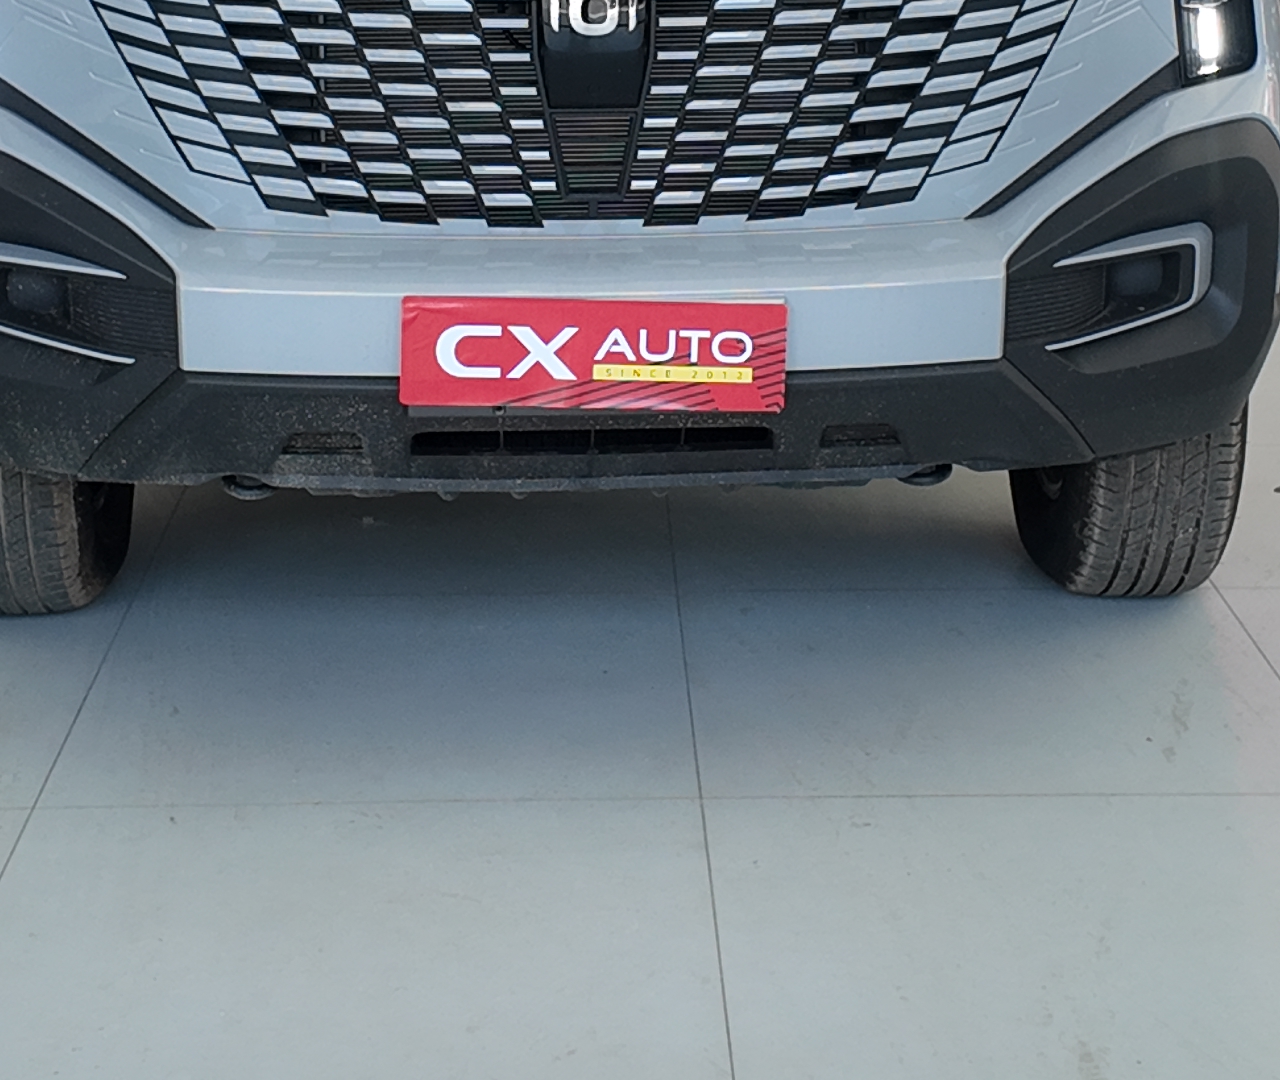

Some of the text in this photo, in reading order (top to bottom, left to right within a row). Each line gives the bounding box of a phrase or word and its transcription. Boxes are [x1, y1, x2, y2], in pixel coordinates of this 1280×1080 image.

[435, 324, 753, 381] CX AUTO
[605, 367, 745, 381] SINCE 2012
